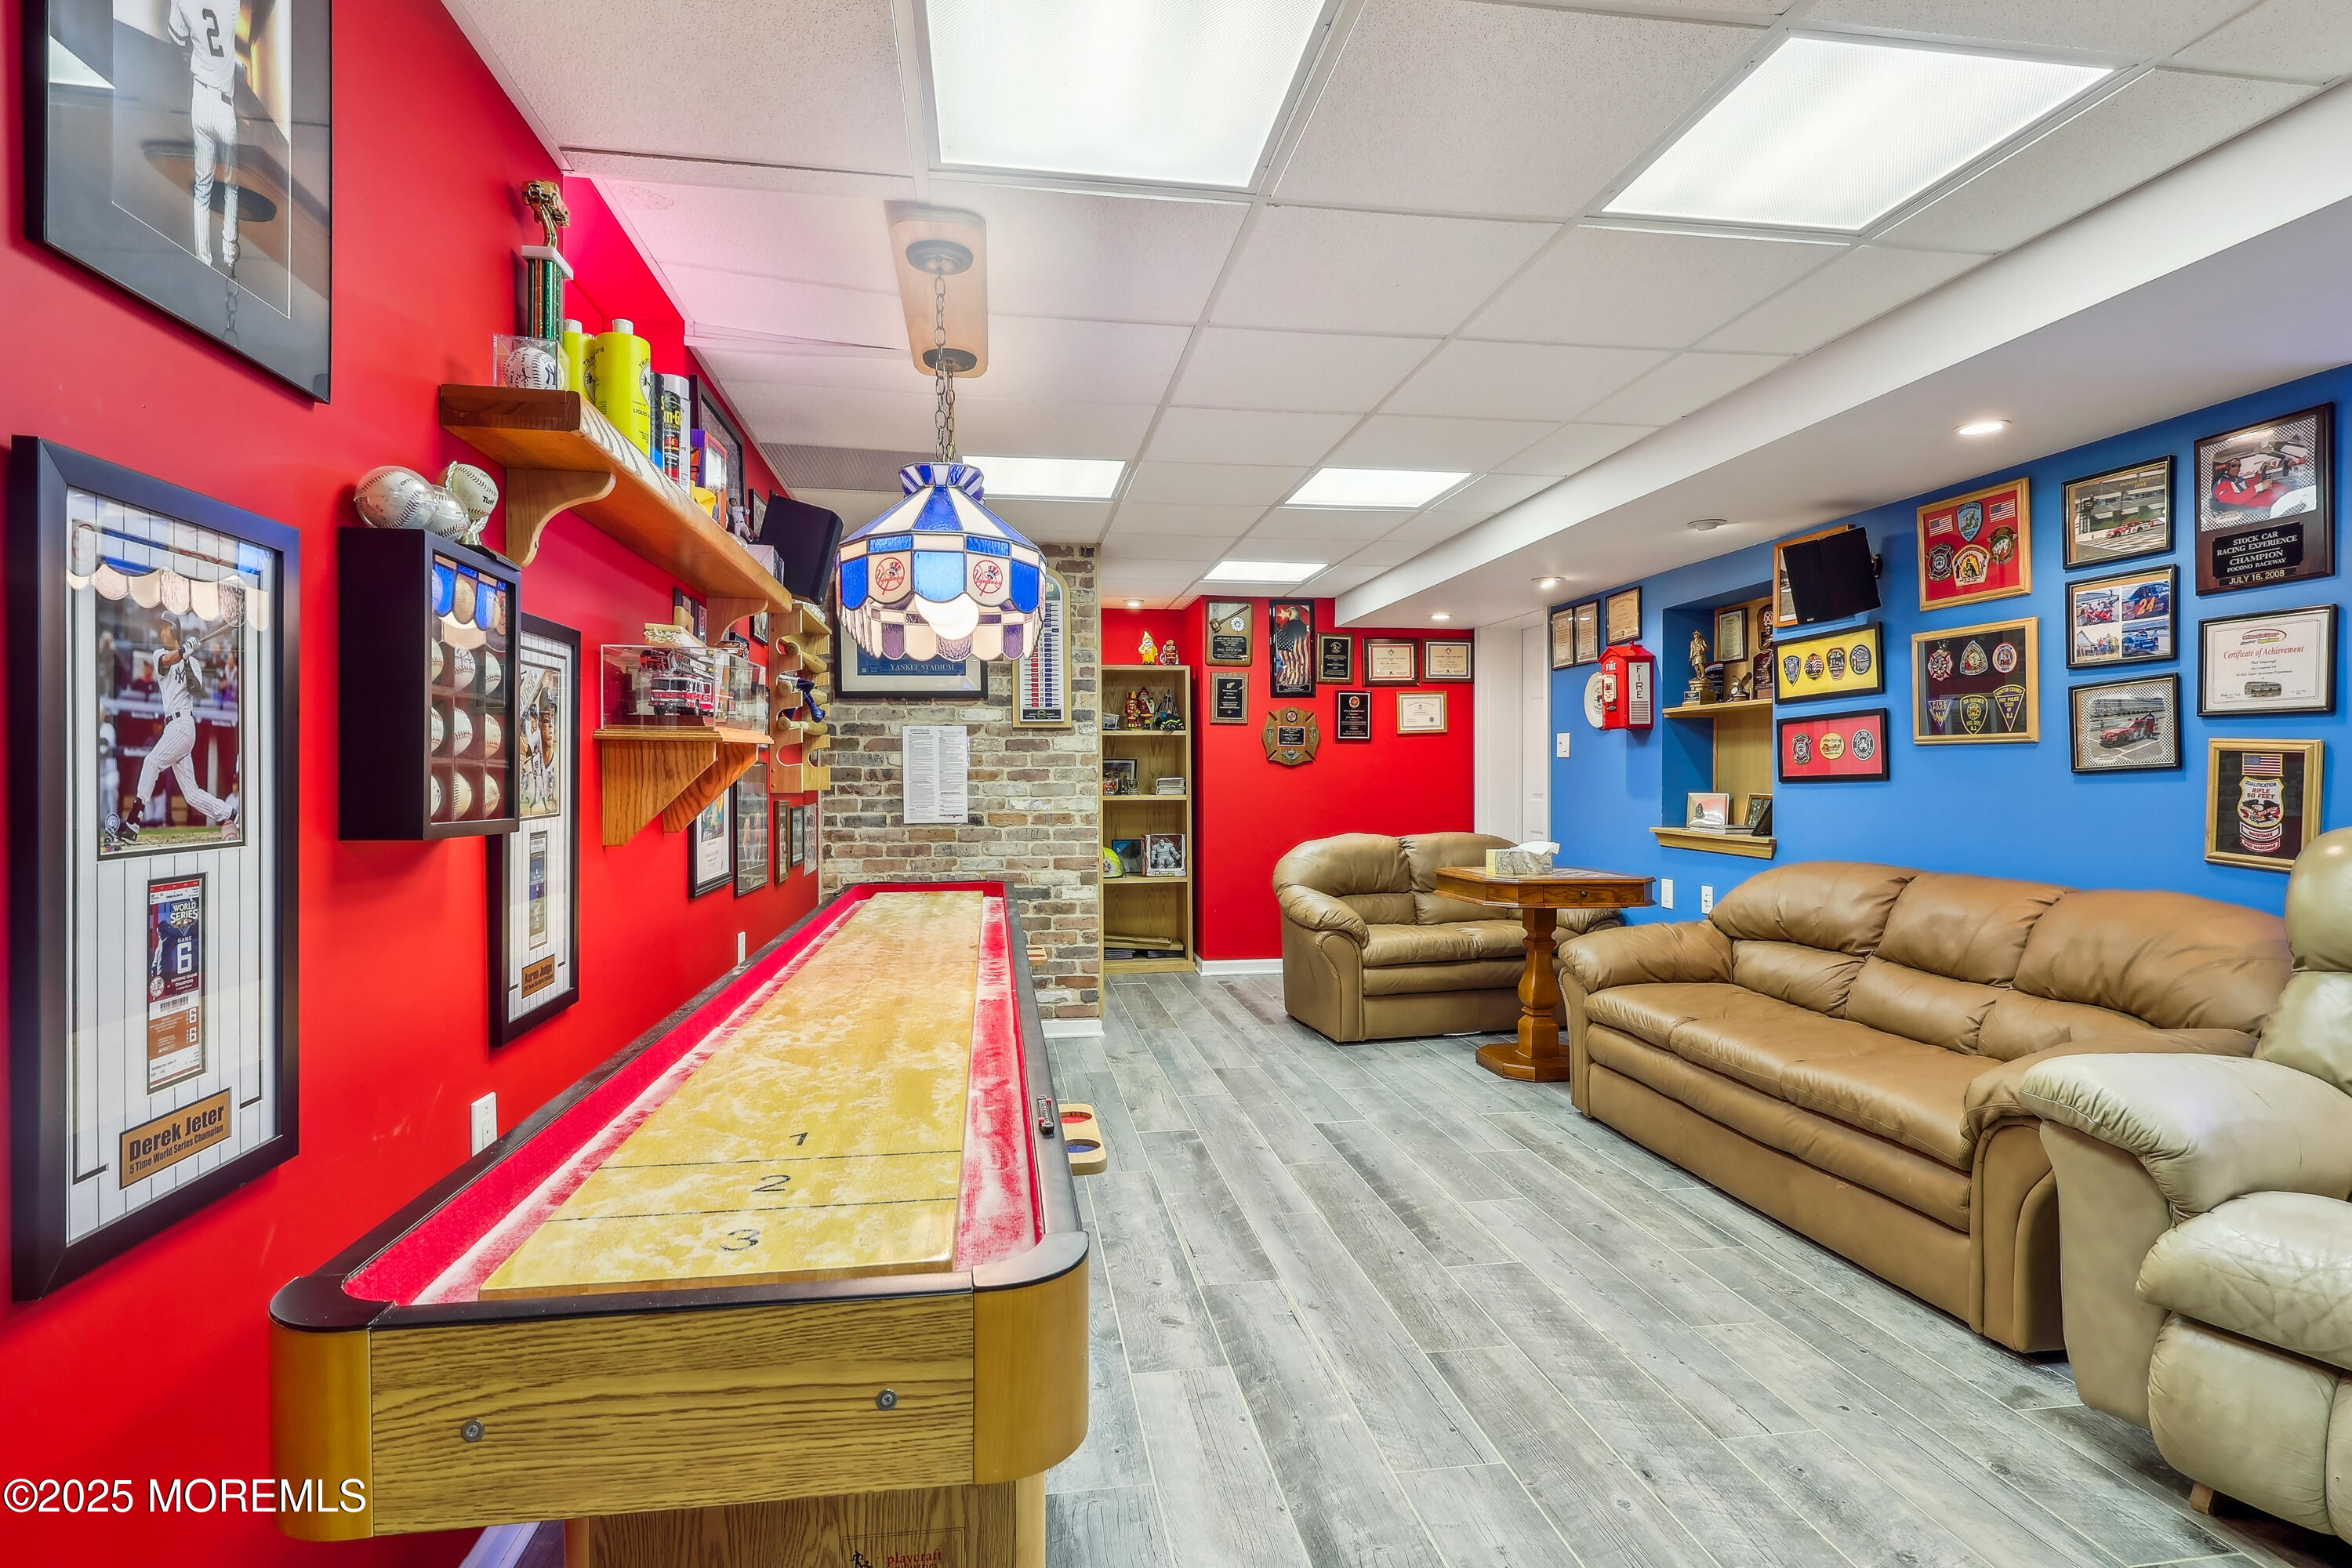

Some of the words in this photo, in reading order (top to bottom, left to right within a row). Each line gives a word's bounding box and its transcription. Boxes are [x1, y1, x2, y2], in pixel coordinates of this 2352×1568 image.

[202, 9, 224, 57] 2
[2216, 545, 2246, 556] RACING
[2249, 535, 2298, 550] EXPERIENCE
[2233, 535, 2259, 546] STOCK
[2261, 531, 2278, 540] CAR
[2227, 564, 2253, 573] POCONO
[2255, 557, 2287, 568] RACEWAY
[2229, 550, 2284, 565] CHAMPION
[2229, 575, 2249, 585] JULY
[2265, 569, 2285, 579] 2008
[2136, 596, 2156, 617] 24
[2223, 650, 2254, 660] Certificate
[2255, 648, 2263, 658] of
[2263, 645, 2304, 656] Achievement
[1606, 662, 1617, 672] FIRE
[172, 902, 196, 912] WORLD
[170, 909, 198, 924] SERIES
[177, 942, 192, 974] 6
[129, 1122, 182, 1162] Derek
[185, 1105, 224, 1136] Jeter
[789, 1131, 808, 1146] 1
[129, 1164, 134, 1174] 5
[136, 1157, 152, 1171] Time
[153, 1146, 172, 1163] World
[173, 1138, 194, 1154] Series
[194, 1124, 223, 1144] Champion
[752, 1174, 791, 1192] 2
[720, 1229, 760, 1251] 3
[887, 1548, 942, 1567] playcraft
